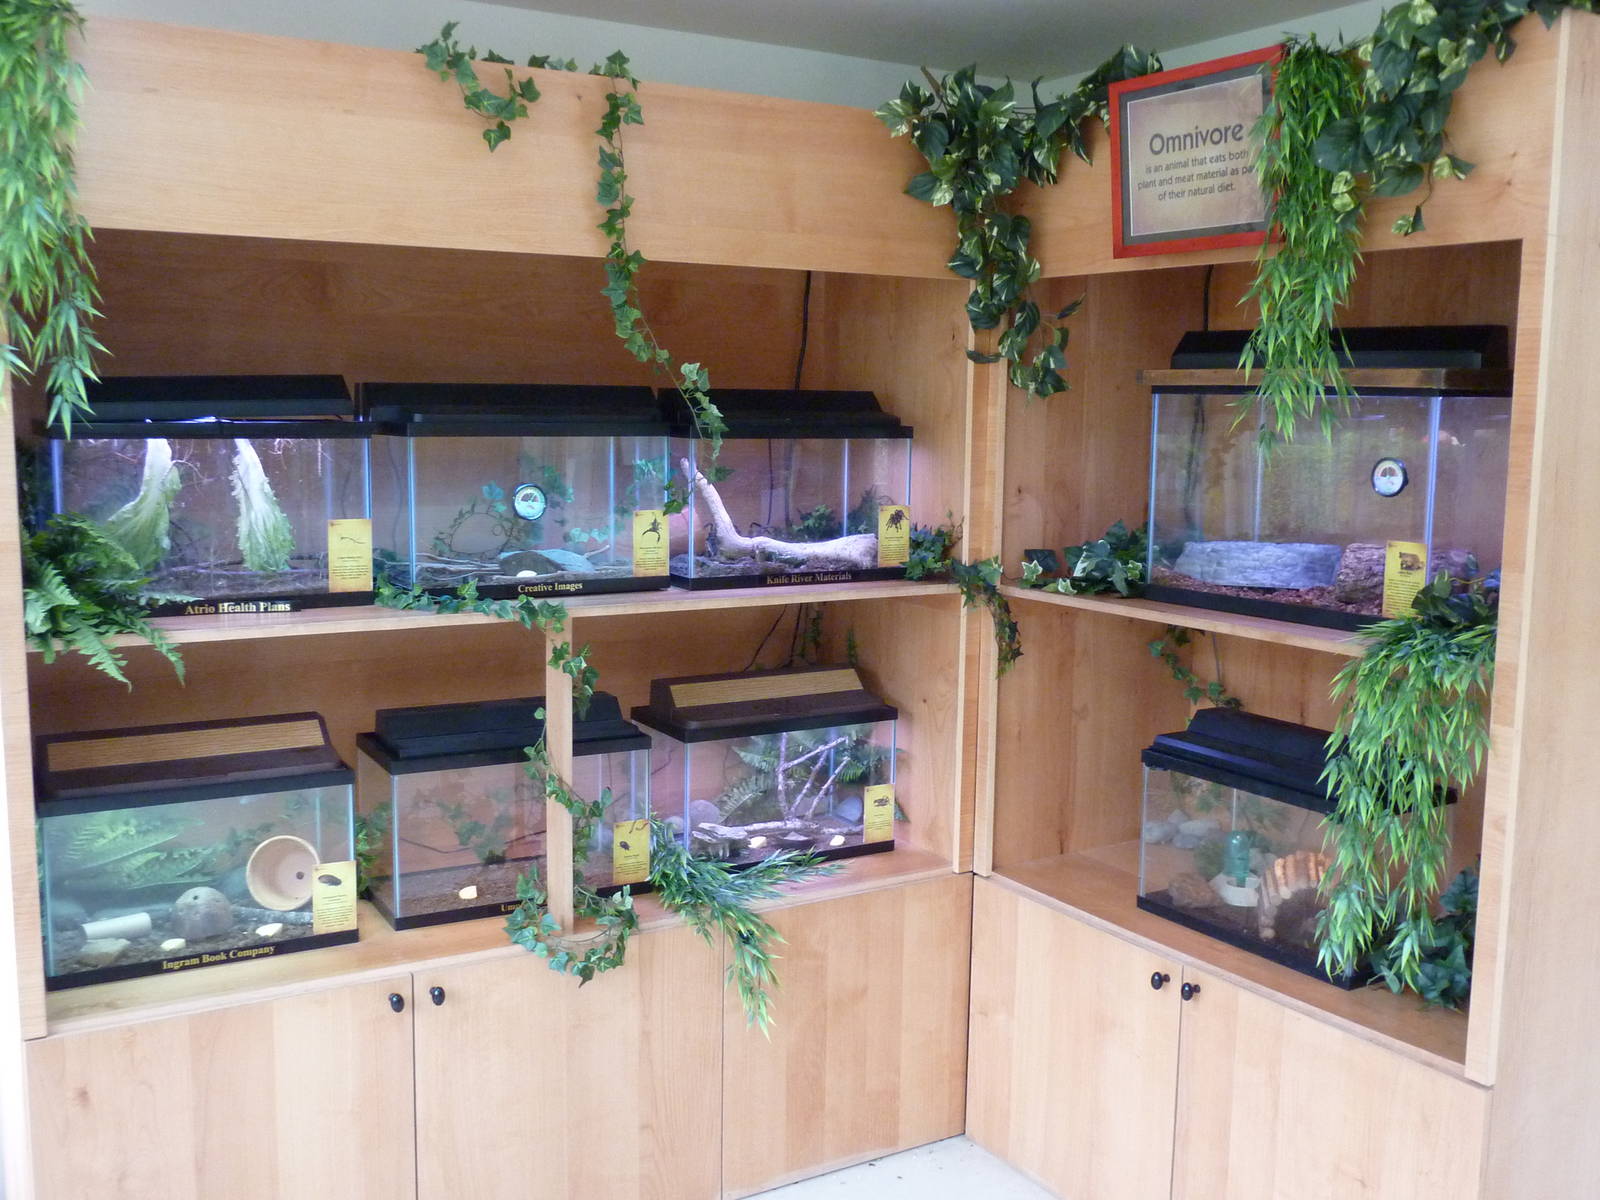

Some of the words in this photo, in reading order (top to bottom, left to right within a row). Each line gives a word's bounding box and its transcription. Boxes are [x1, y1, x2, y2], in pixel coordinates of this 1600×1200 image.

[1149, 123, 1244, 156] Omnivore
[1145, 163, 1152, 174] is
[1153, 164, 1164, 173] an
[1164, 158, 1190, 171] animal
[1191, 156, 1207, 168] that
[1209, 153, 1226, 164] eats
[1228, 149, 1249, 161] both
[1137, 179, 1157, 192] plant
[1158, 175, 1173, 187] and
[1174, 173, 1194, 183] meat
[1196, 167, 1228, 181] material
[1230, 168, 1239, 176] as
[1158, 190, 1167, 201] of
[1168, 188, 1186, 199] their
[1188, 183, 1216, 197] natural
[1217, 181, 1236, 193] diet.
[517, 583, 553, 593] Creative
[554, 582, 583, 591] Images
[791, 573, 814, 583] River
[184, 604, 216, 615] Atrio
[218, 602, 256, 613] Health
[259, 601, 291, 612] Plans
[162, 956, 201, 970] Ingram
[202, 951, 227, 963] Book
[228, 945, 276, 959] Company
